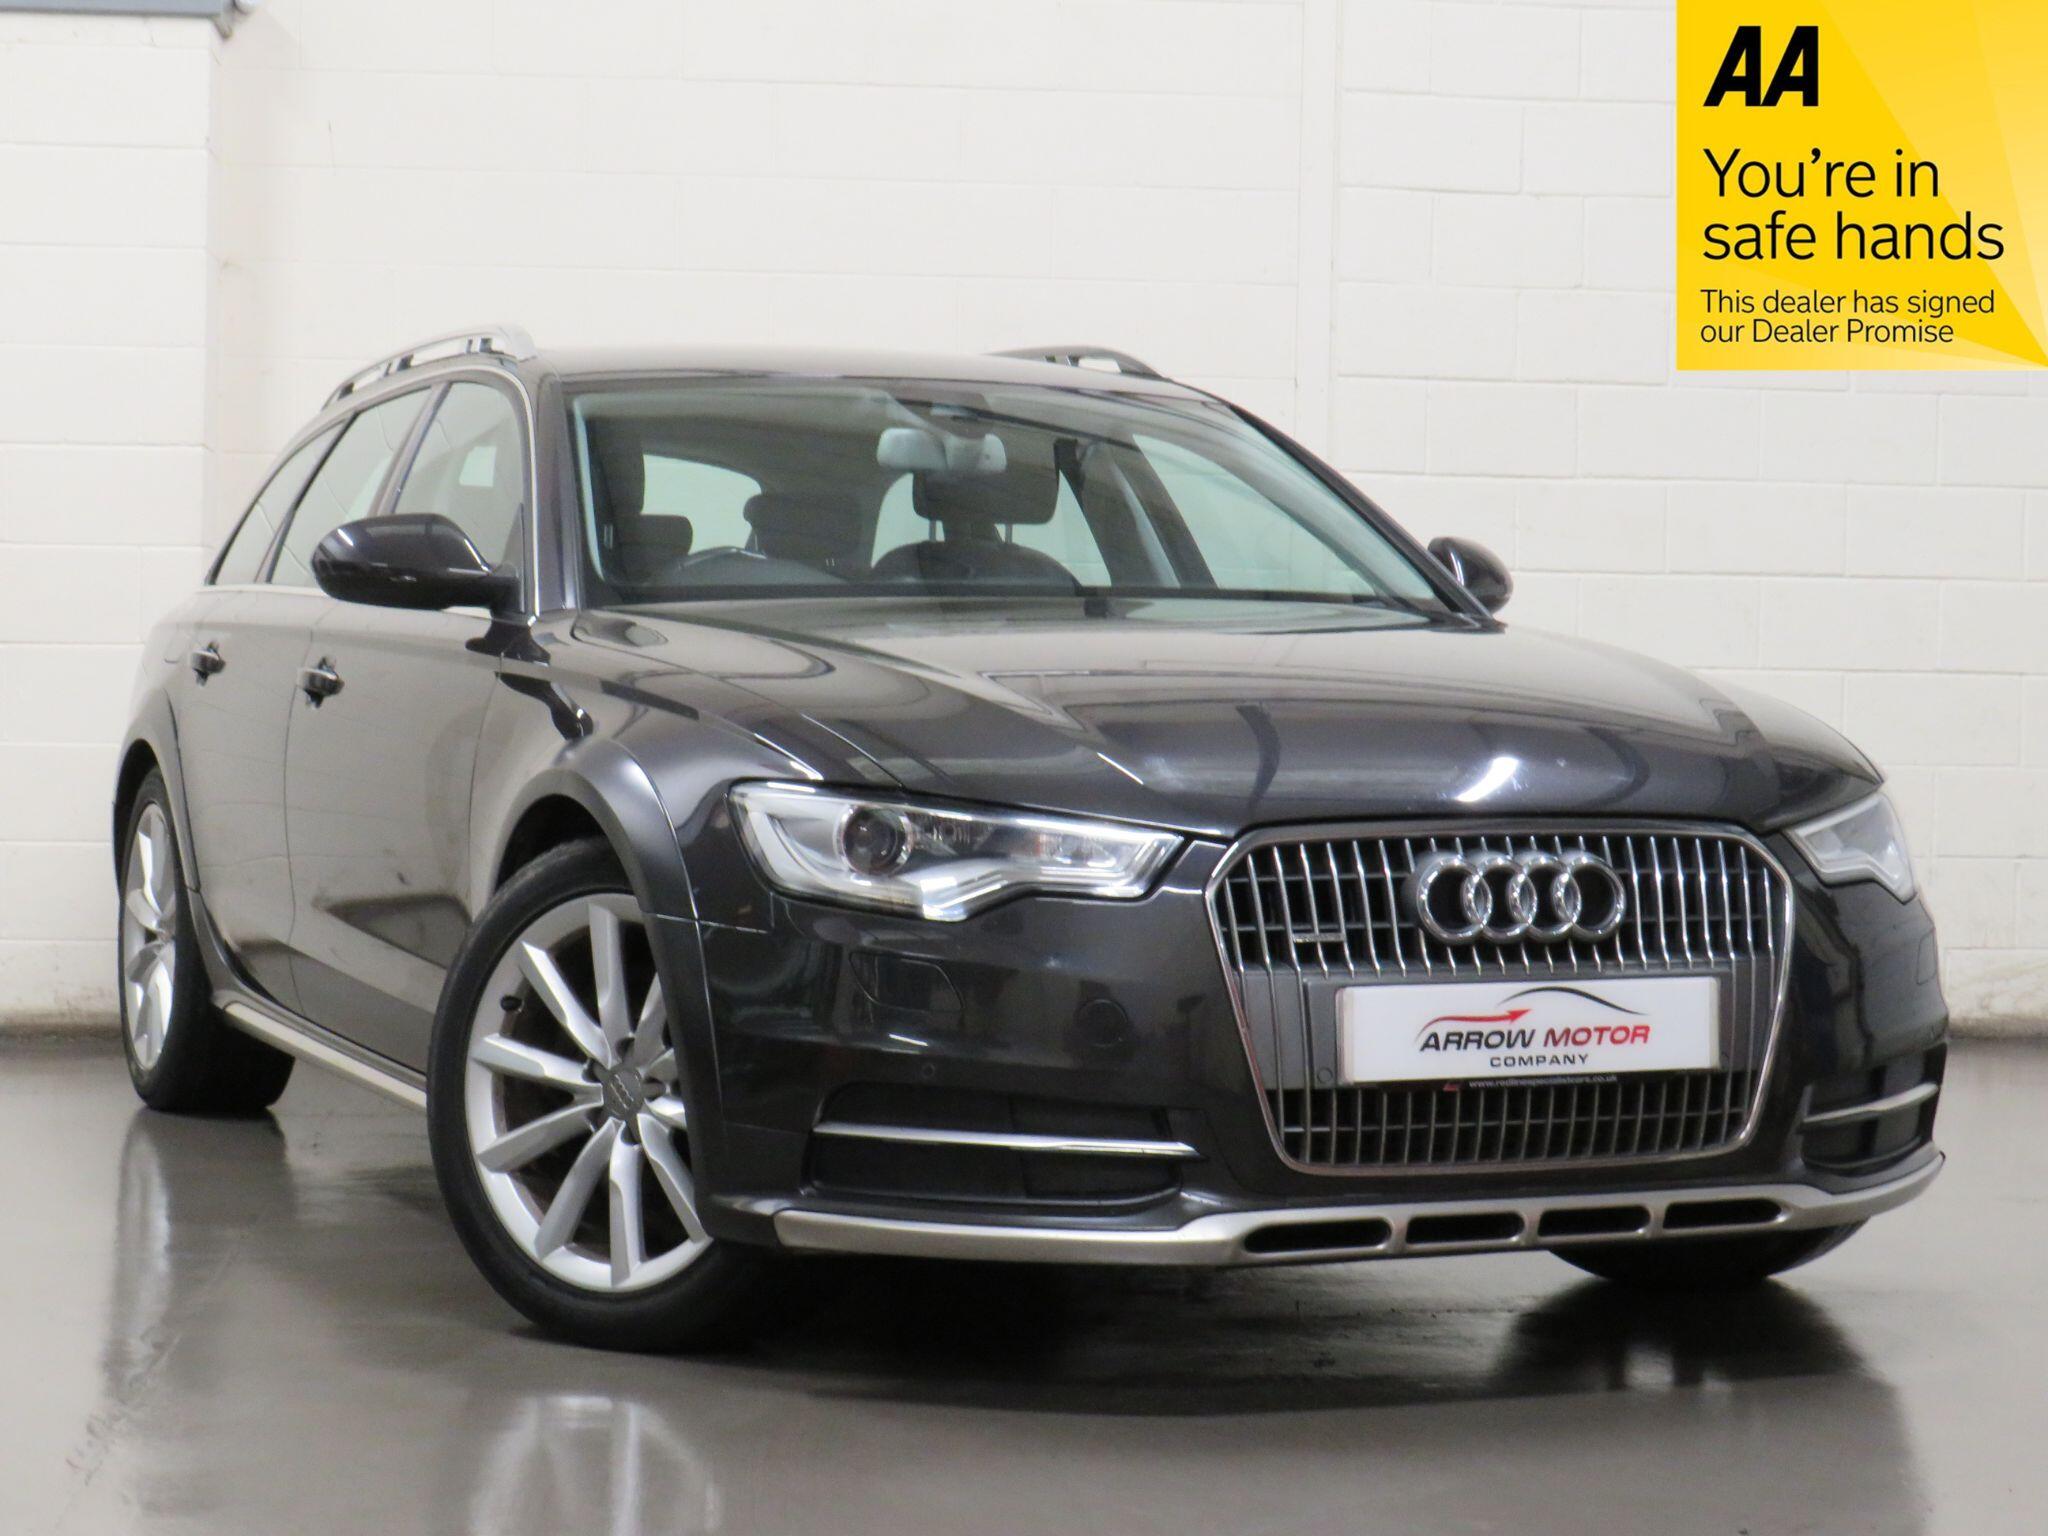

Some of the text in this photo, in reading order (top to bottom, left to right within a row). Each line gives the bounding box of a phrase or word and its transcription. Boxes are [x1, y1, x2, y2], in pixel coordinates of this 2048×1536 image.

[1419, 1025, 1650, 1052] ARROW MOTOR
[1489, 1053, 1589, 1068] COMPANY
